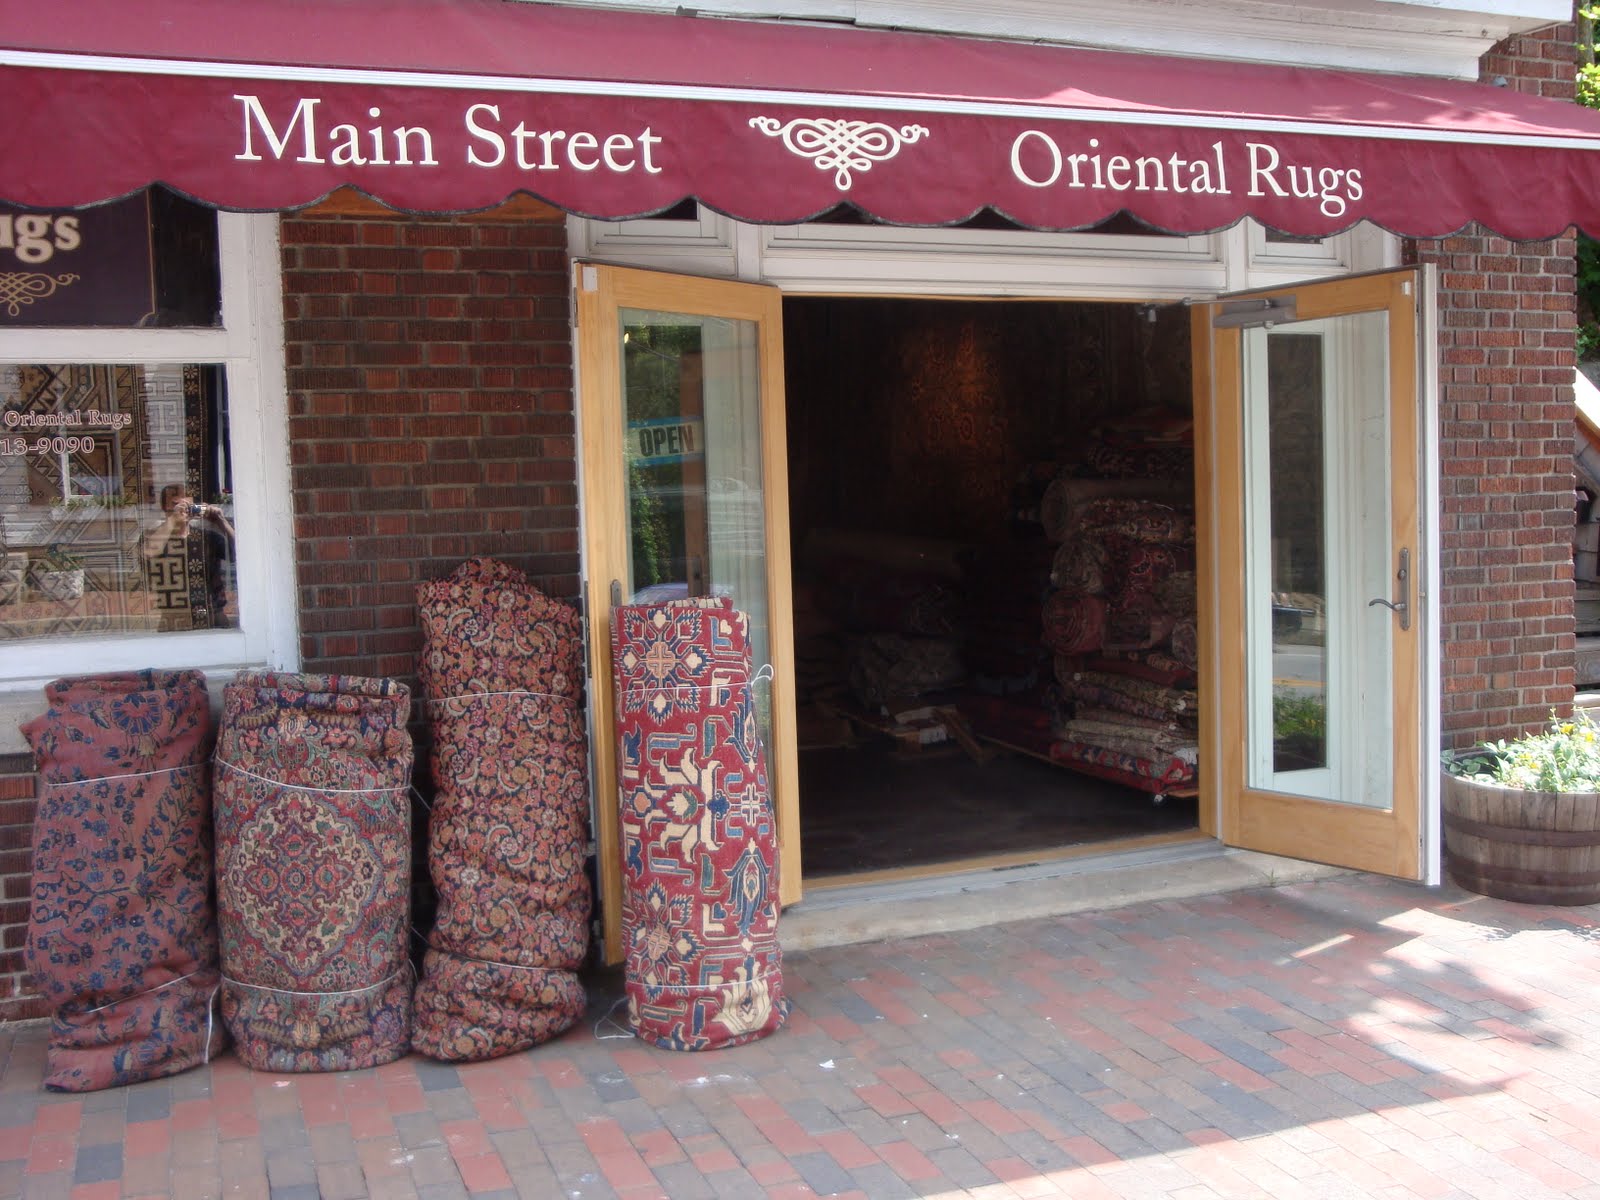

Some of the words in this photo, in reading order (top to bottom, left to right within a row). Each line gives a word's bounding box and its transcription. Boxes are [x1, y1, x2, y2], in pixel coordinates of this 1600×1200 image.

[233, 94, 439, 166] Main
[465, 103, 663, 173] Street
[1010, 129, 1232, 195] Oriental
[1246, 142, 1364, 218] Rugs
[4, 409, 83, 427] Oriental
[88, 409, 132, 430] Rugs
[0, 436, 95, 456] 13-9090
[639, 424, 695, 457] OPEN
